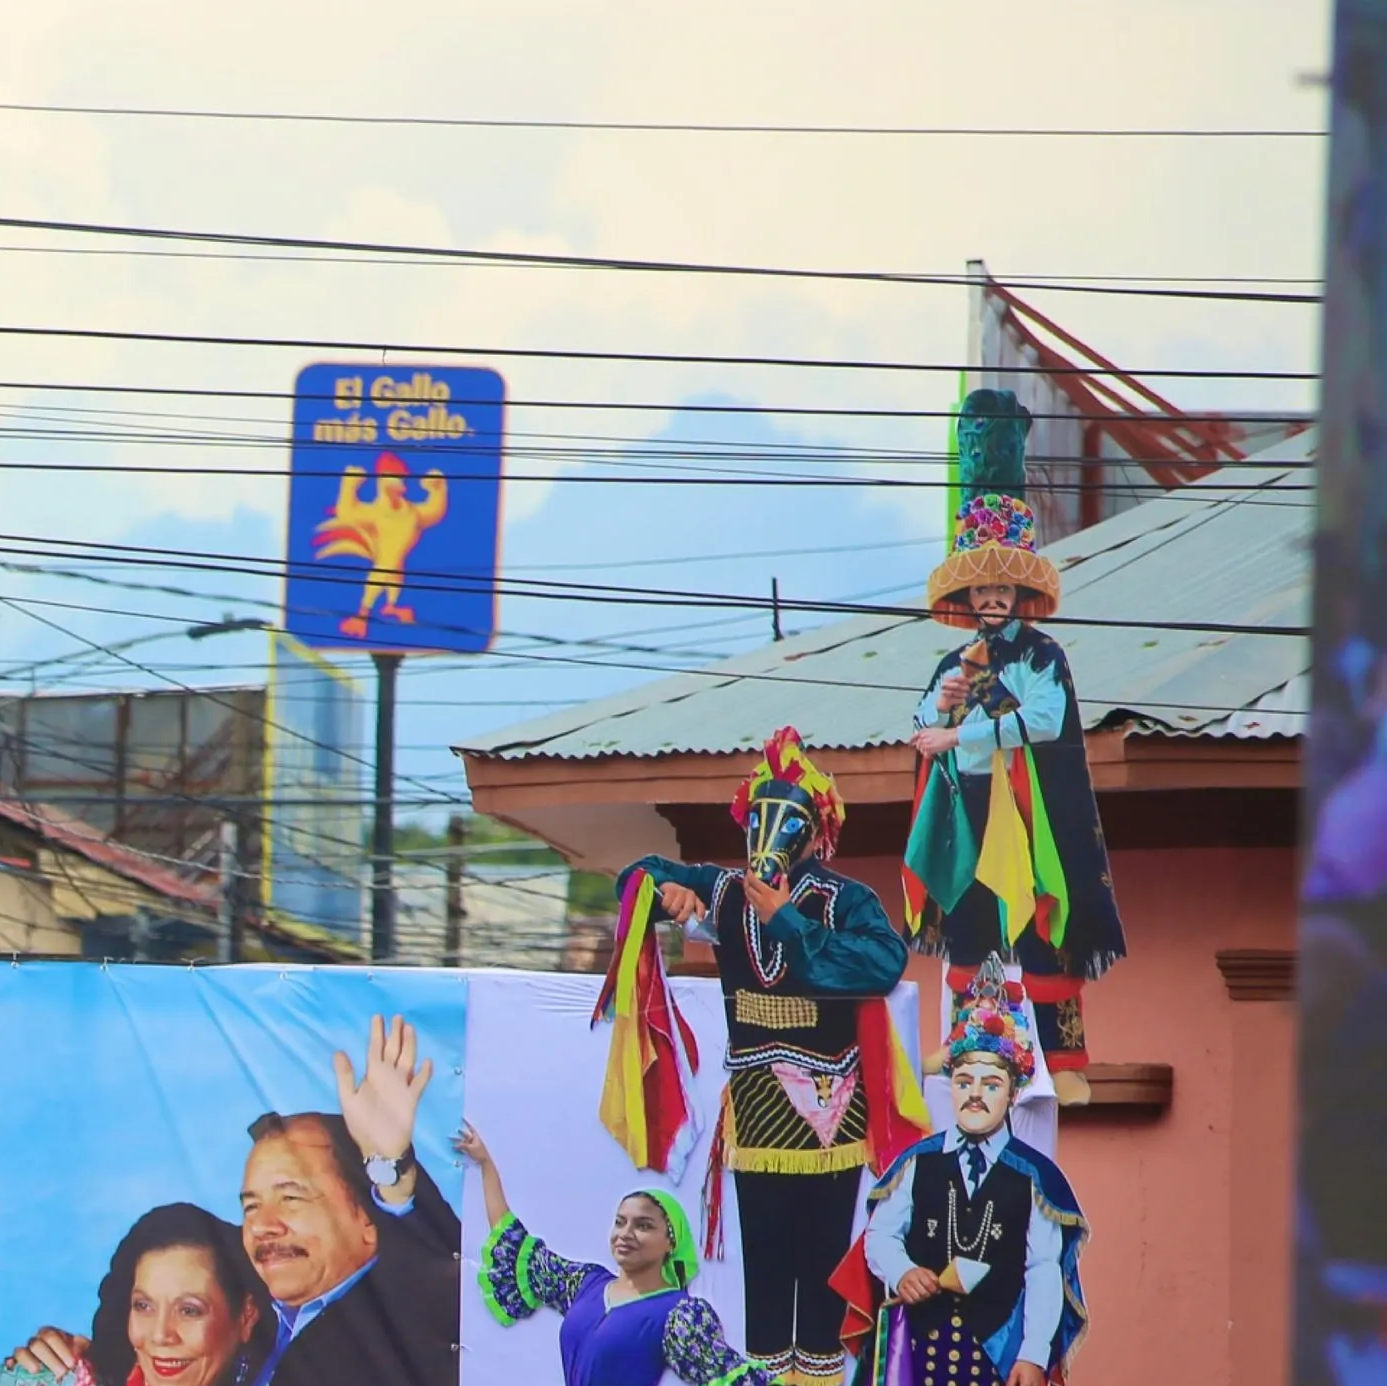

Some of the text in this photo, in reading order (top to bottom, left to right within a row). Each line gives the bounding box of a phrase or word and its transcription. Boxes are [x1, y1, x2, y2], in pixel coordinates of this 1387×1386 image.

[334, 372, 450, 410] El Gallo
[313, 412, 378, 443] más
